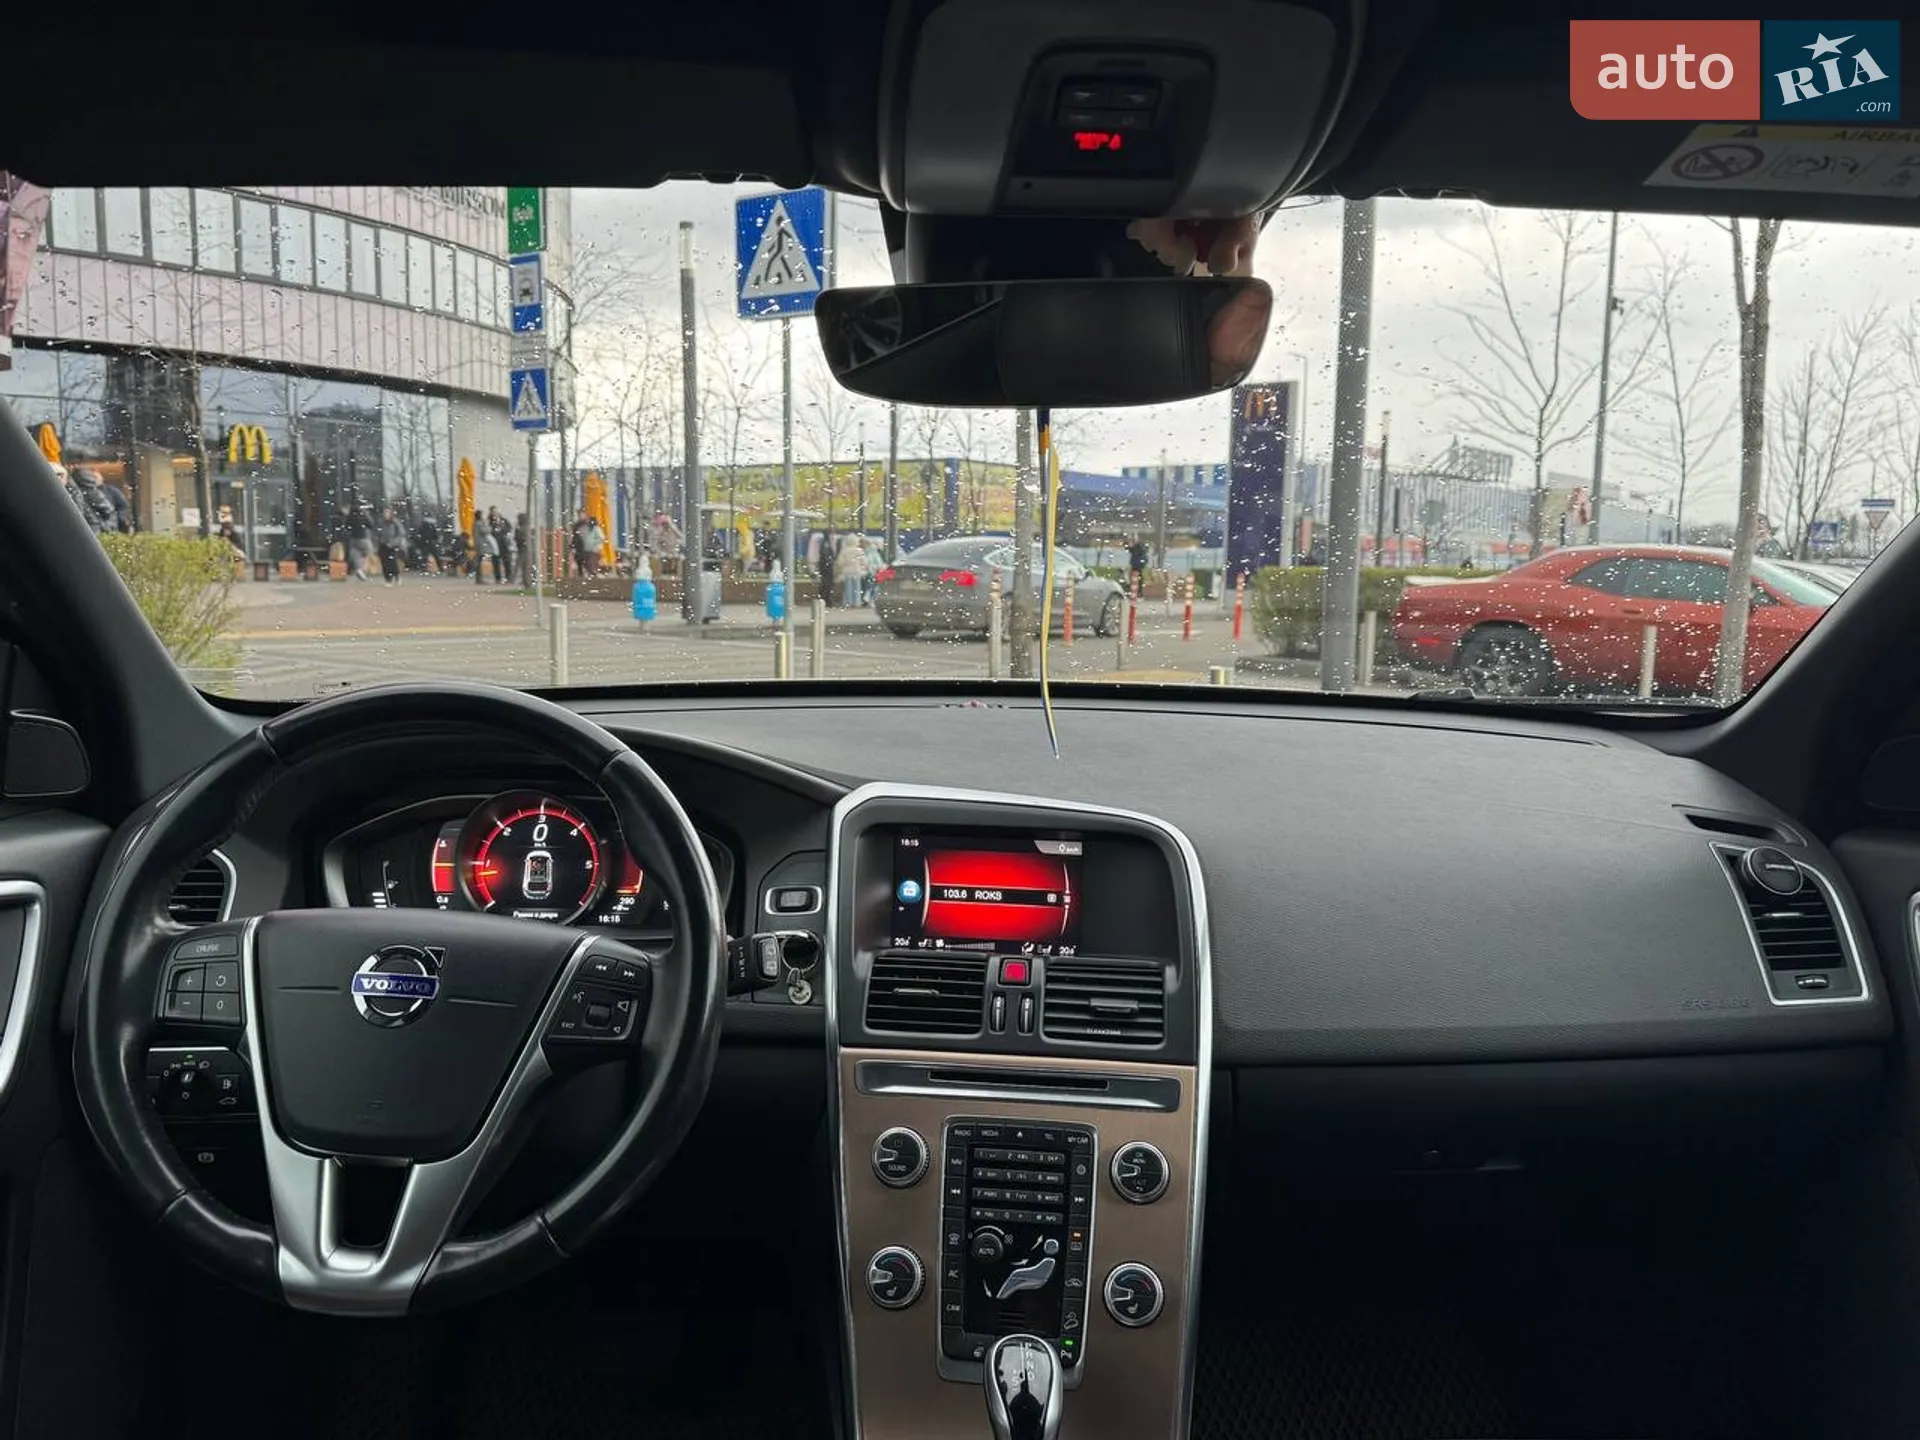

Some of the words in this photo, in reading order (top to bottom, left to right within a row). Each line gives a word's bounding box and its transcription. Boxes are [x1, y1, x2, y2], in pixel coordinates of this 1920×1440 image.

[532, 823, 548, 842] 0
[974, 890, 1003, 902] ROKS
[360, 977, 430, 993] VOLVO
[978, 1247, 995, 1256] AUTO
